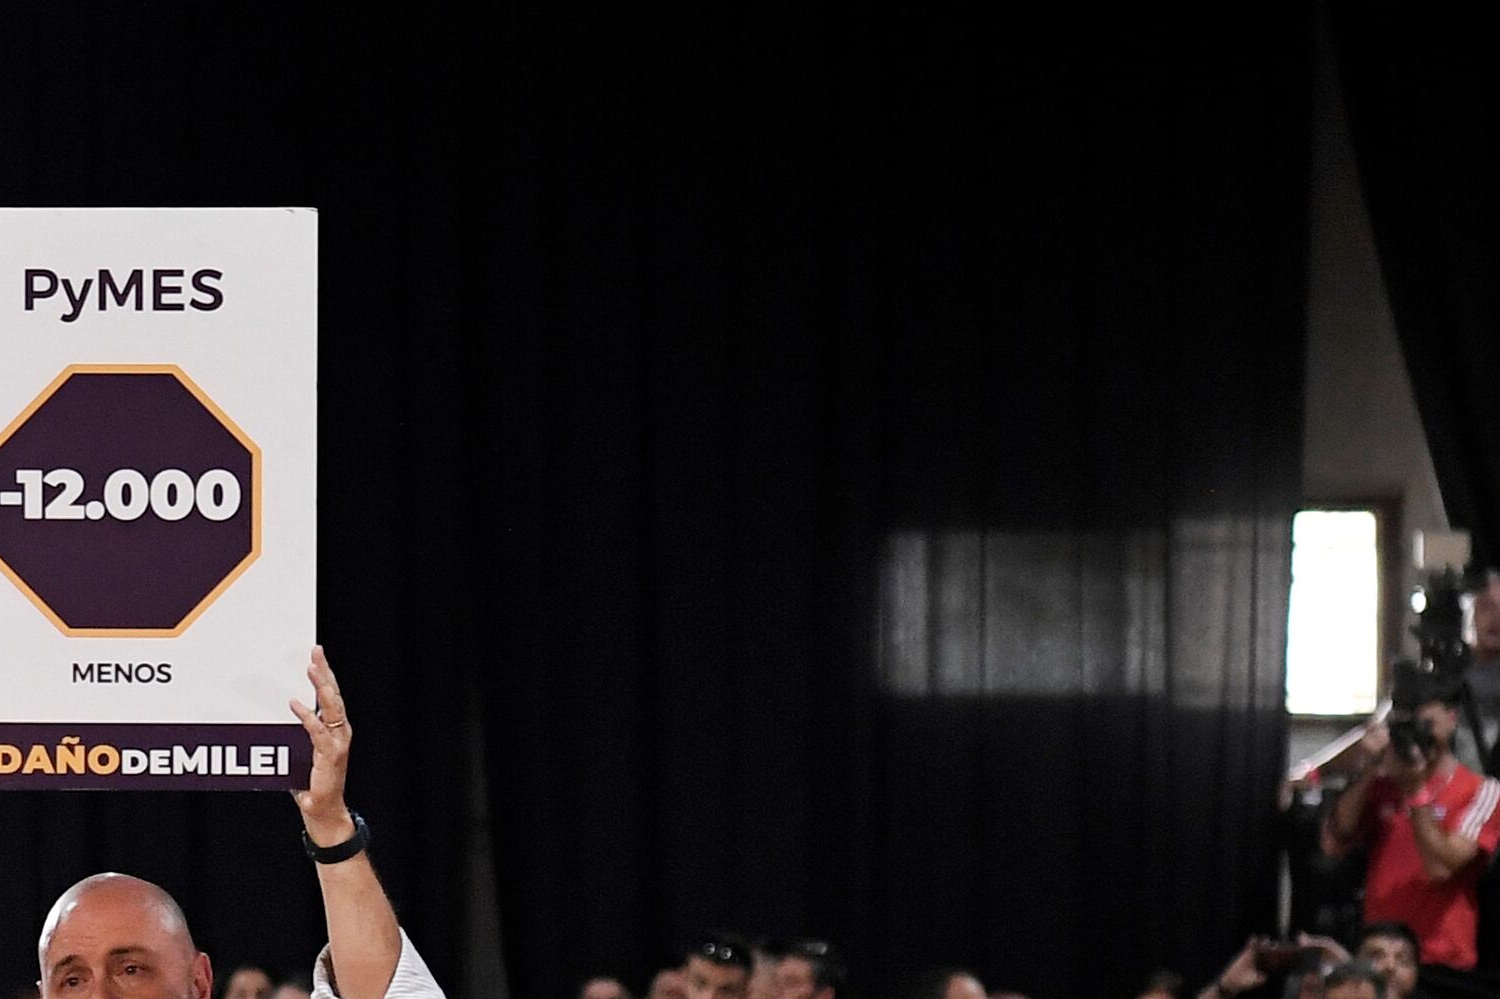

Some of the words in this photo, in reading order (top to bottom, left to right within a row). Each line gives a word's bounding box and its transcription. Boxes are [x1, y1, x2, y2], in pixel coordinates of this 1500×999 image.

[23, 268, 225, 323] PyMES
[0, 468, 241, 522] -12.000
[71, 662, 173, 685] MENOS
